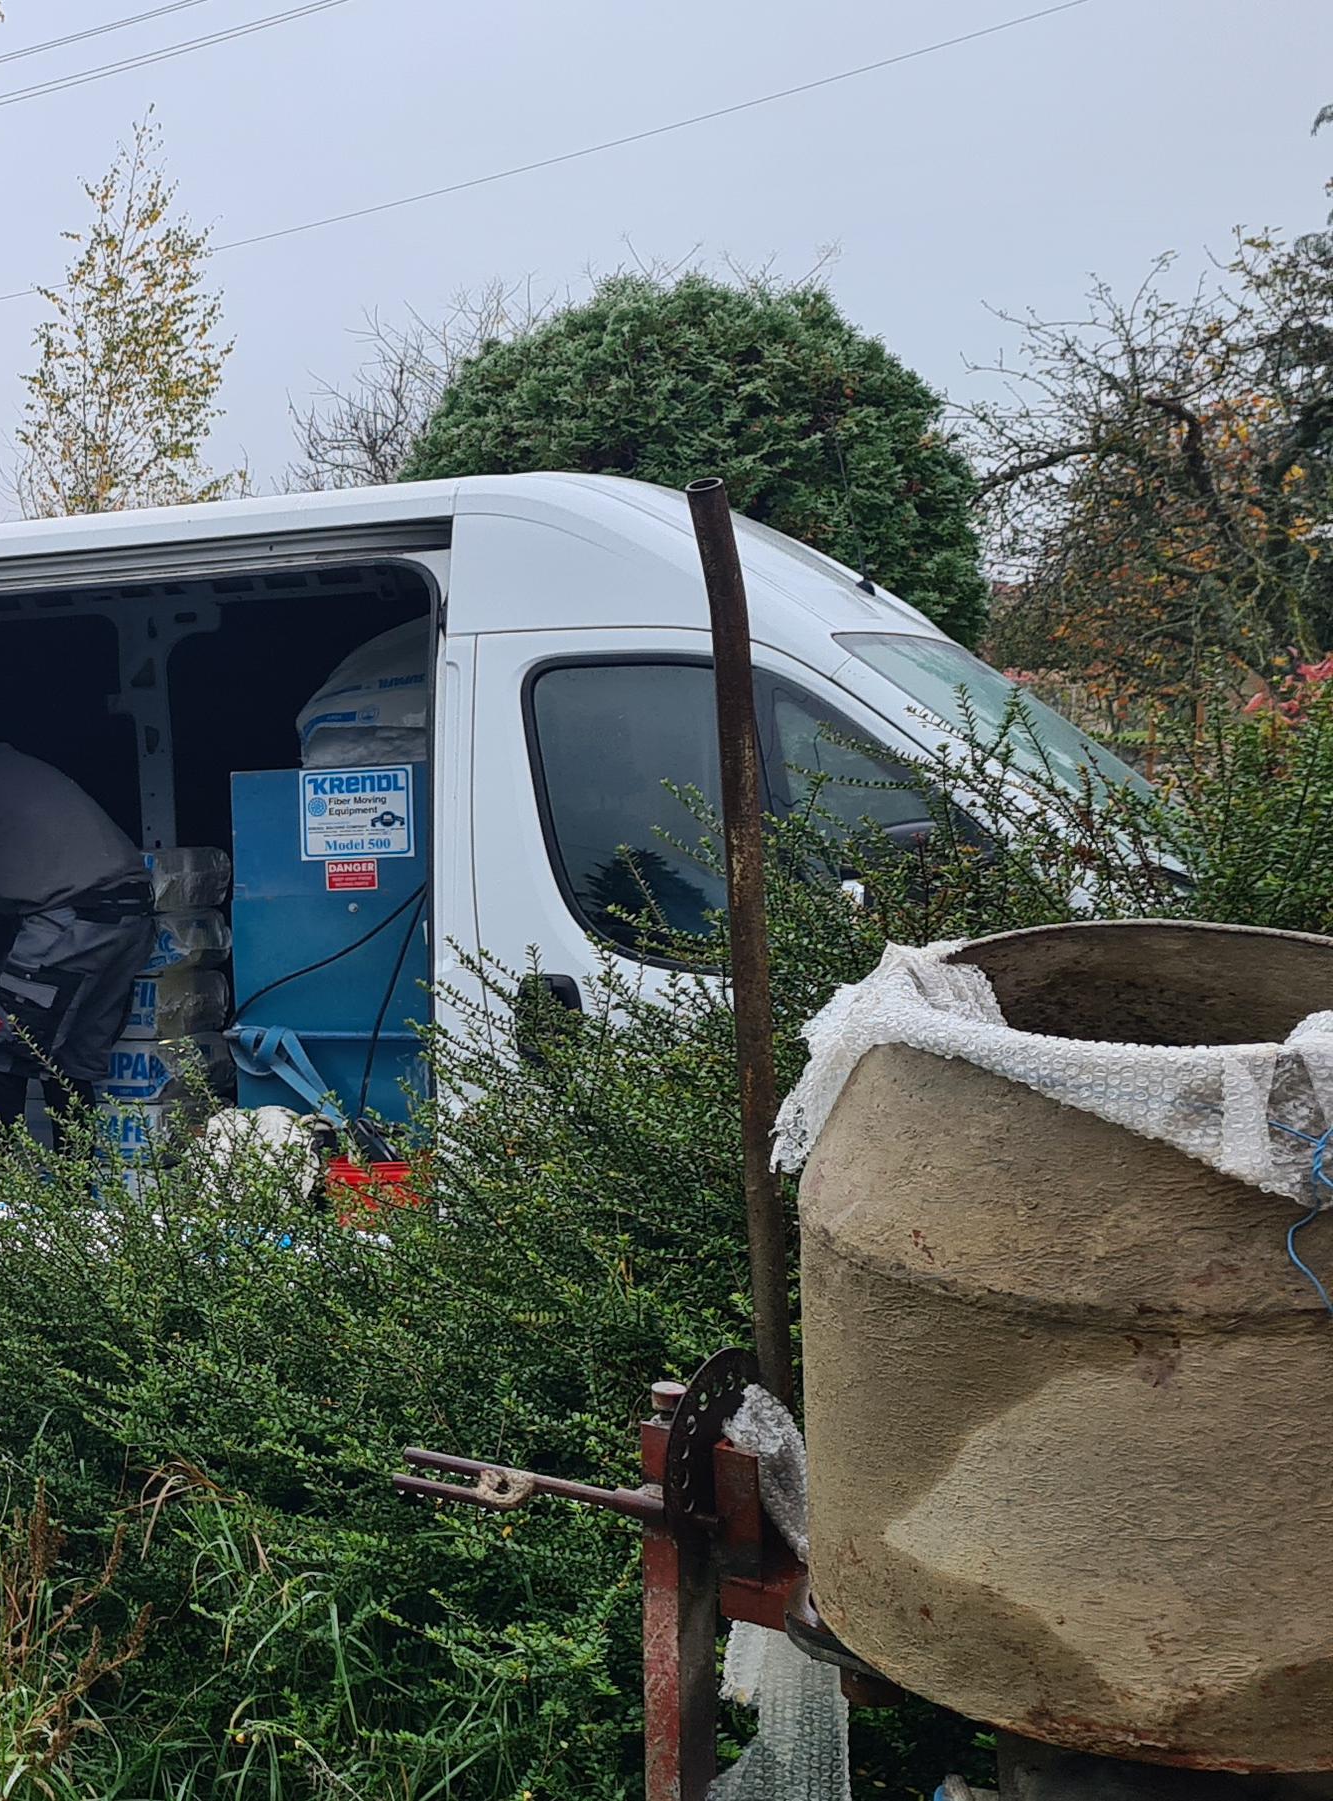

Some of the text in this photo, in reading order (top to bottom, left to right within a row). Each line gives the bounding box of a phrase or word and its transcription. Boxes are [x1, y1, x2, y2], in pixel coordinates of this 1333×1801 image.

[328, 795, 387, 806] Fiber Moving
[328, 806, 378, 816] Equipment
[324, 838, 391, 851] Model 500
[328, 862, 375, 873] DANGER
